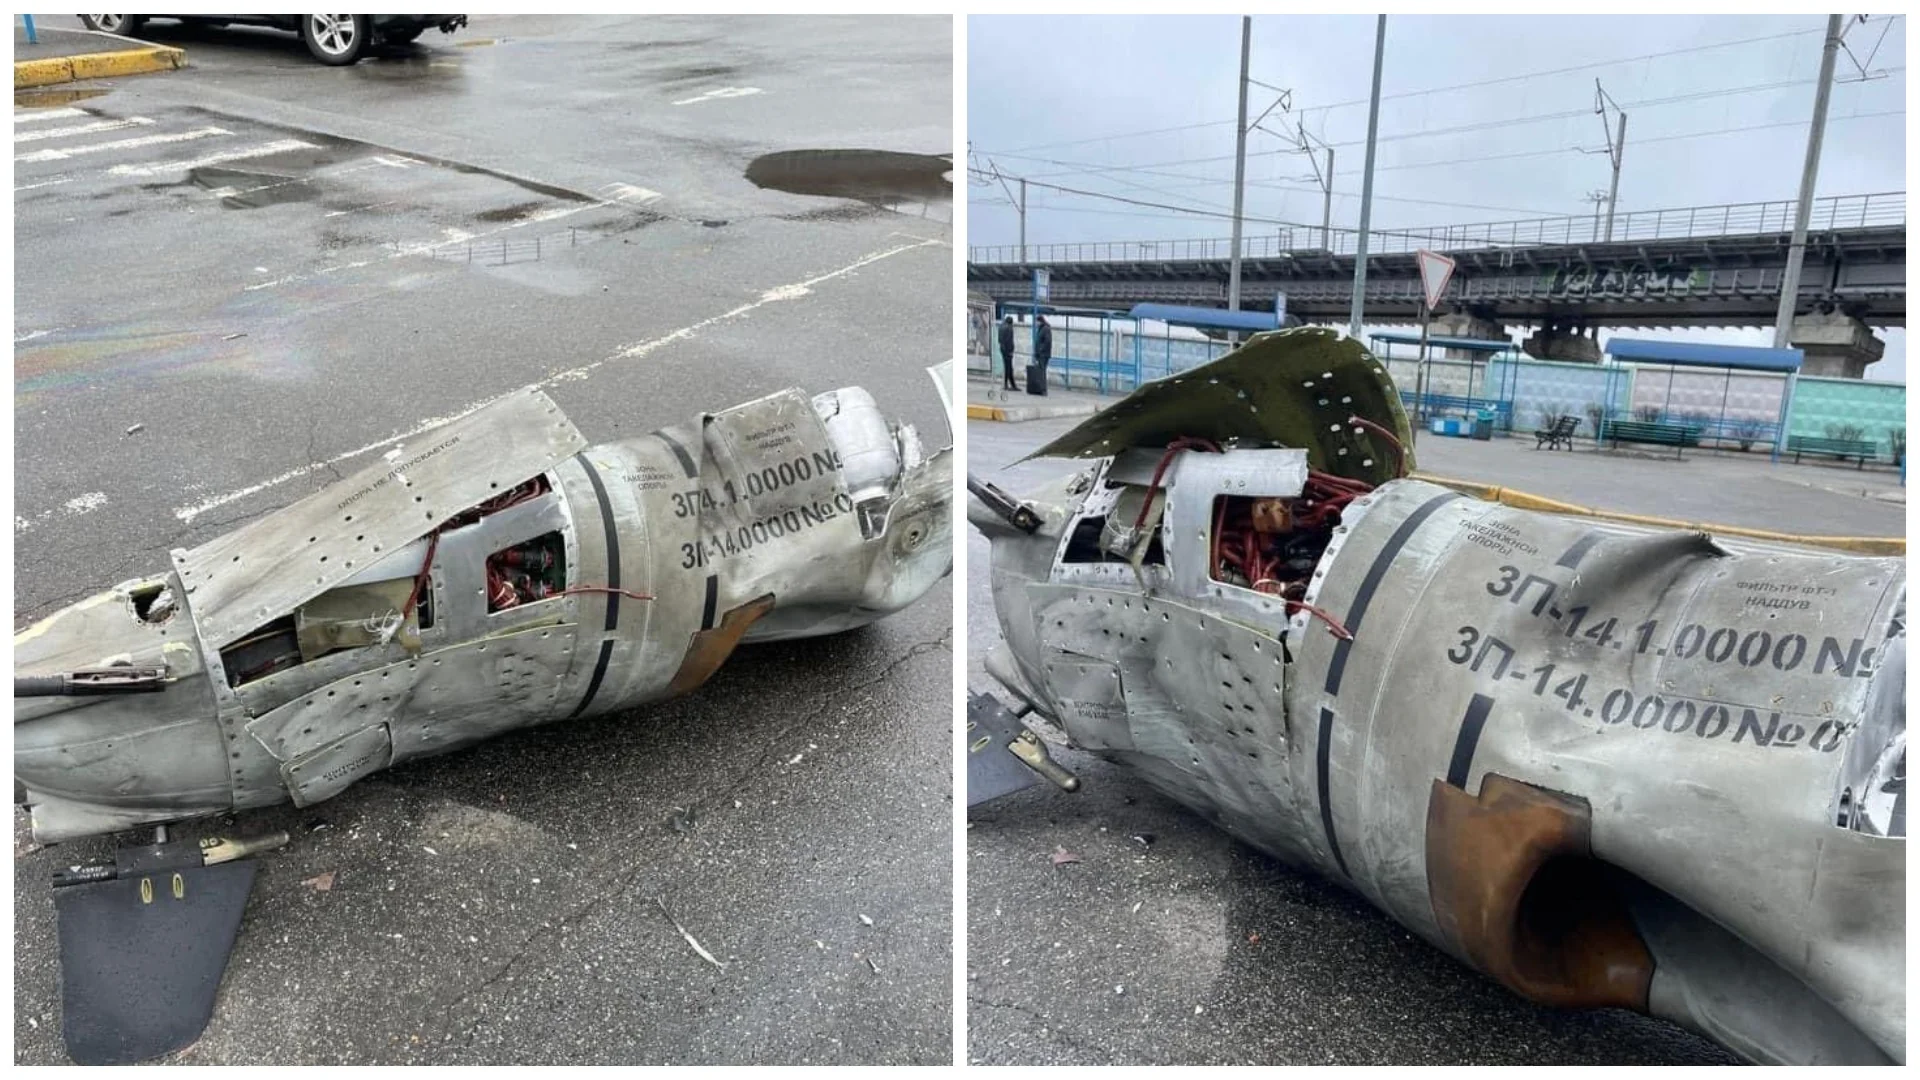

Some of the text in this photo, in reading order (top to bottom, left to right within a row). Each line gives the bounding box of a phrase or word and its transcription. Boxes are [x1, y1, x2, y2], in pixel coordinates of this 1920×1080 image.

[338, 435, 460, 510] ОПОРА НЕ ДОПУСКАЕТСЯ
[1489, 519, 1522, 536] ЗОНА
[1467, 533, 1512, 556] ОПОРЫ
[1736, 581, 1799, 593] ФИЛЬТР
[1745, 596, 1811, 610] НАДДУВ
